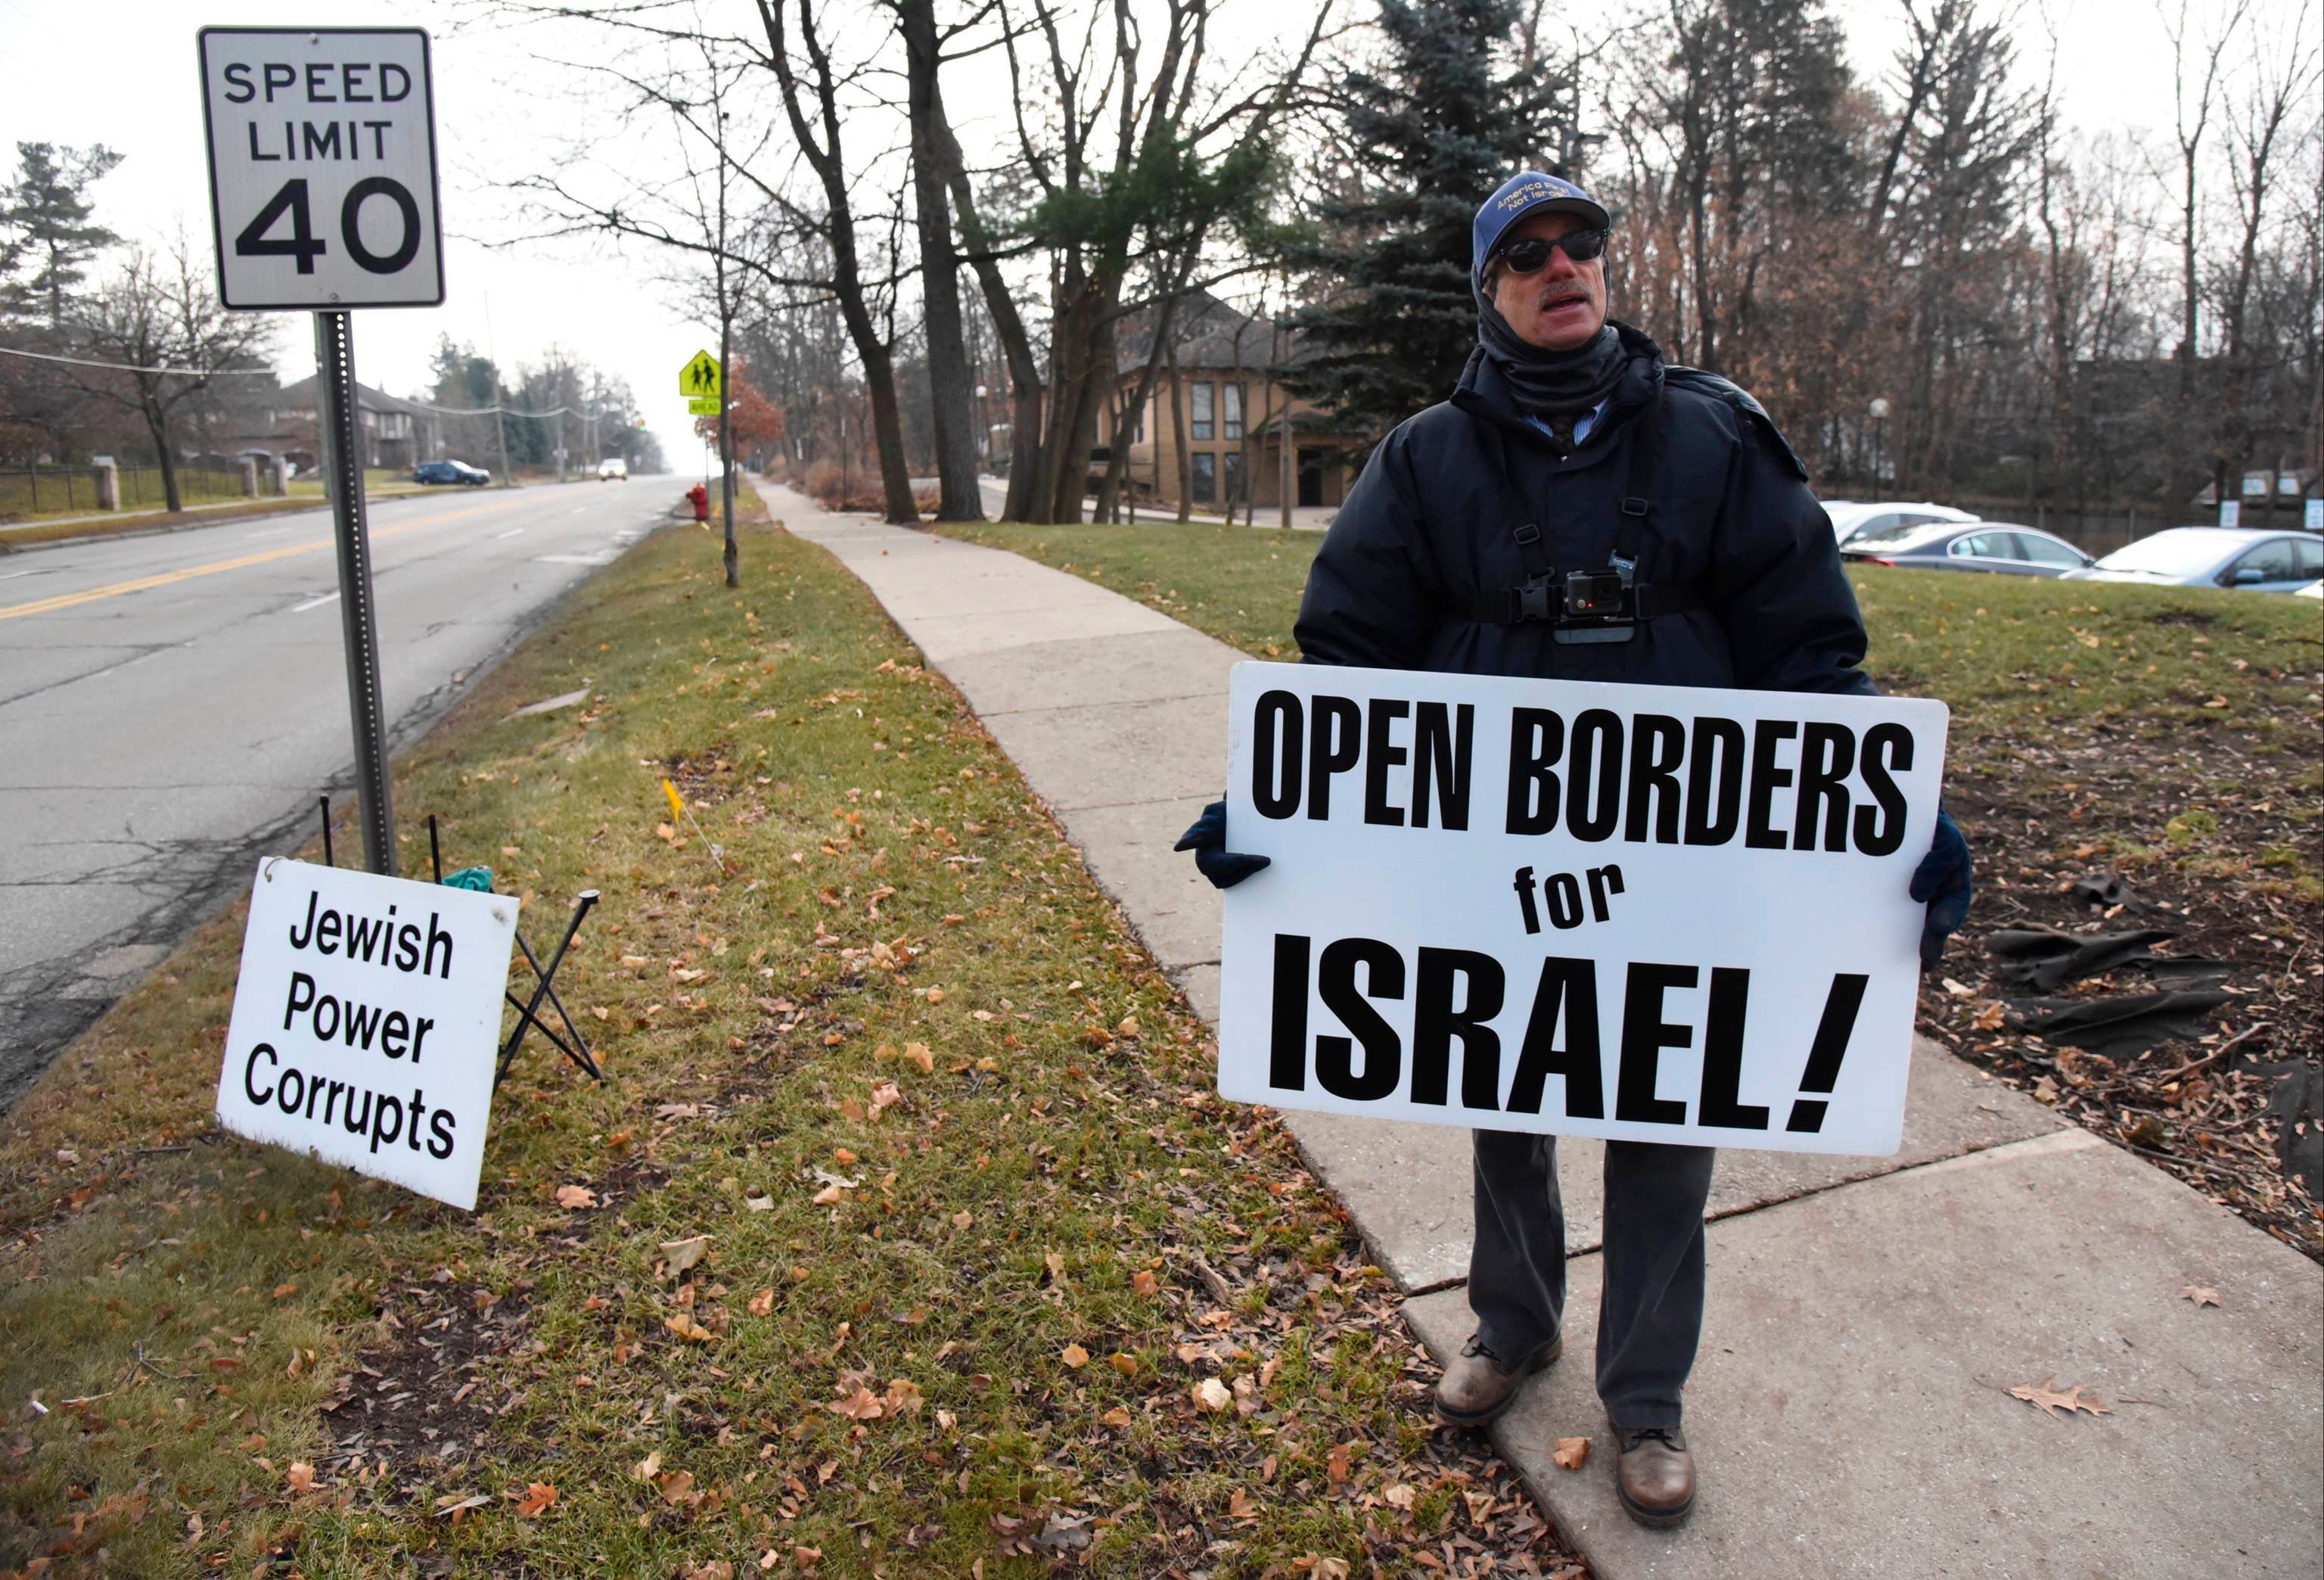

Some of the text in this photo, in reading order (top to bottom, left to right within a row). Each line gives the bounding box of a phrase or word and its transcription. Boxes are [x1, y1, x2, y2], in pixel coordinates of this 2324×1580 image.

[224, 63, 412, 104] SPEED
[248, 121, 393, 161] LIMIT
[235, 176, 421, 275] 40
[1497, 182, 1543, 210] America
[1508, 194, 1529, 212] Not
[1252, 689, 1915, 857] OPEN BORDERS
[290, 891, 453, 979] Jewish
[1513, 863, 1625, 935] for
[284, 971, 434, 1063] Power
[1269, 933, 1870, 1134] ISRAEL!
[244, 1043, 456, 1160] Corrupts
